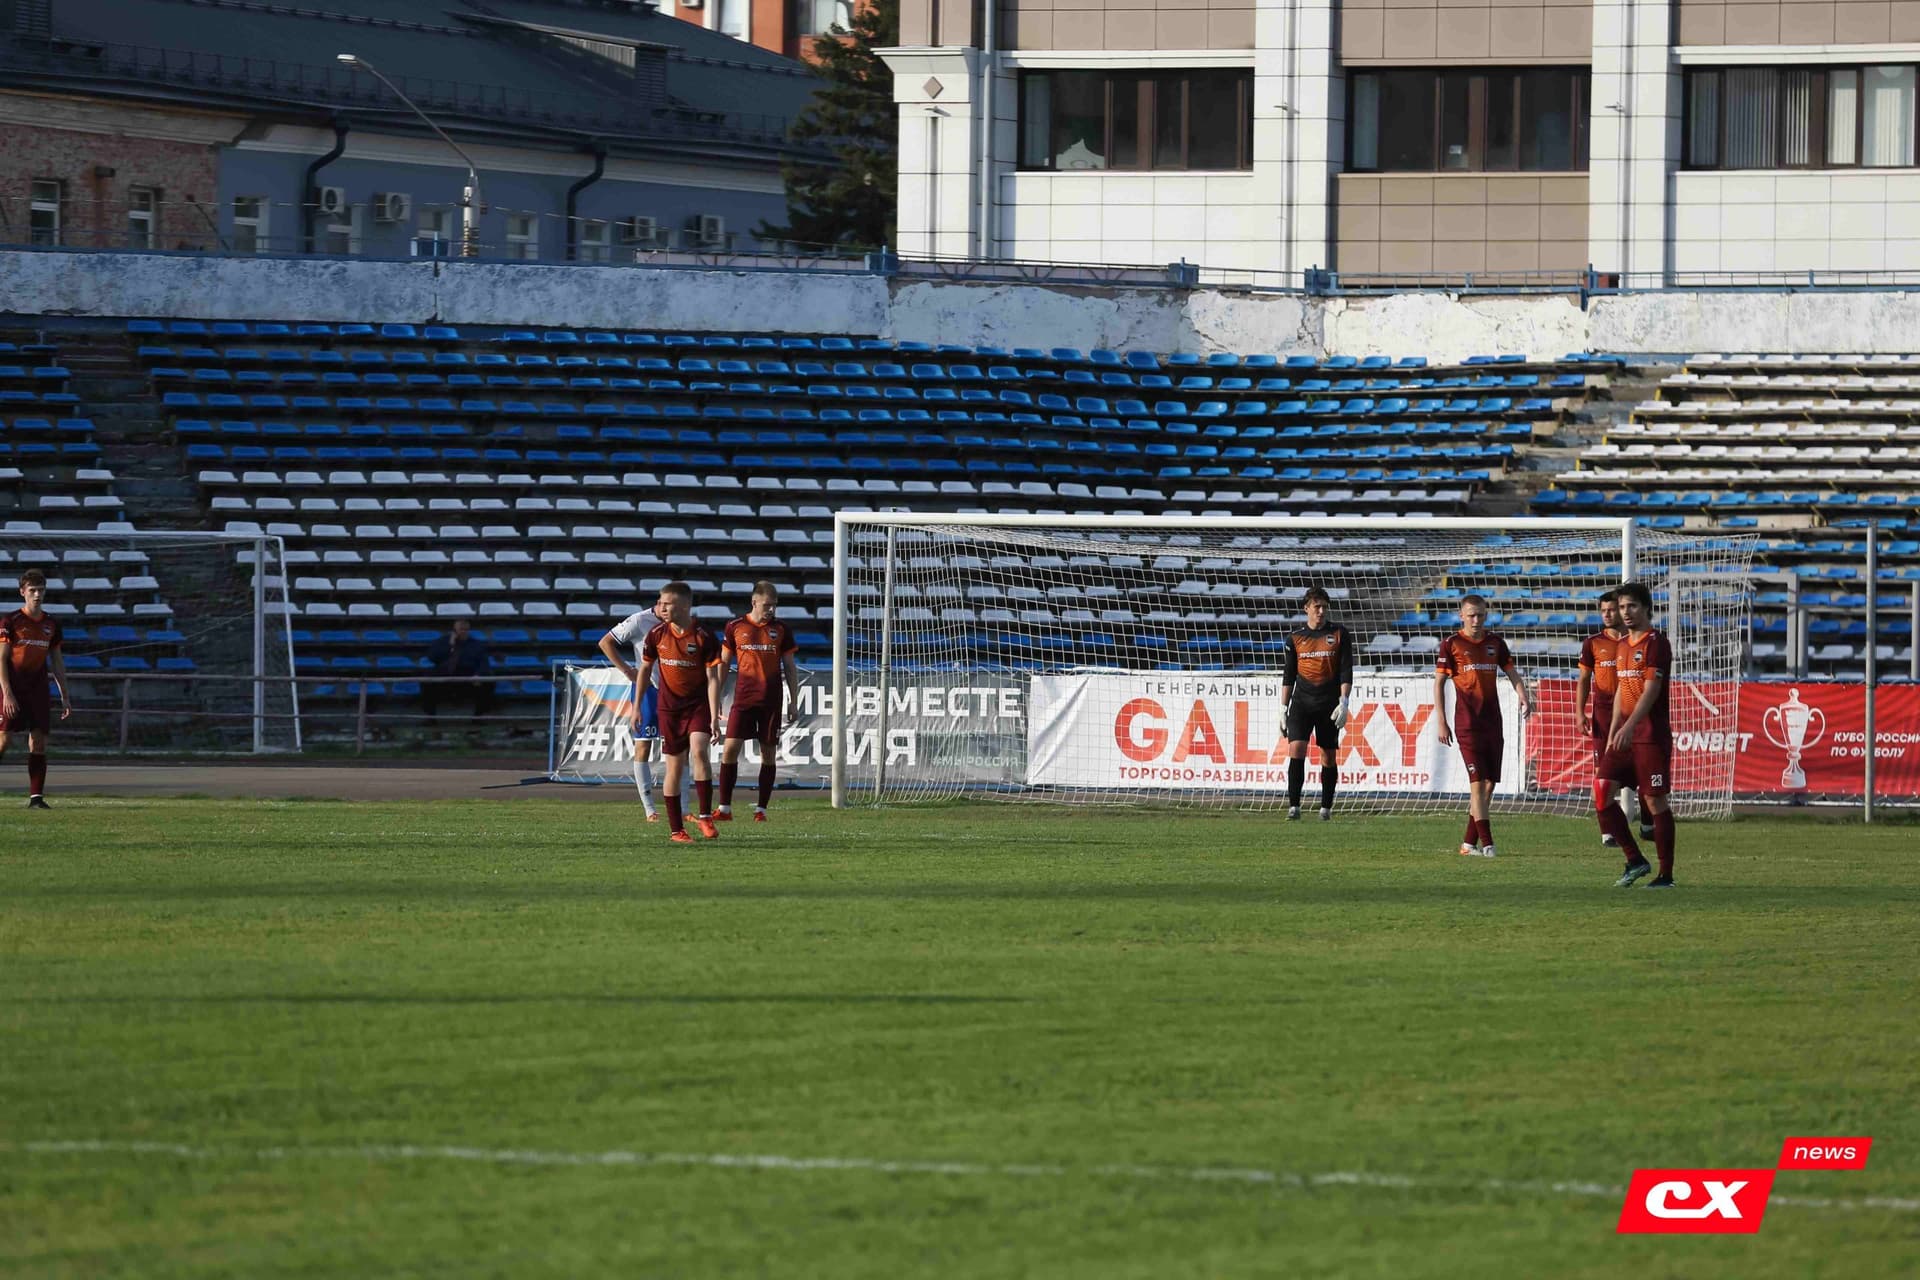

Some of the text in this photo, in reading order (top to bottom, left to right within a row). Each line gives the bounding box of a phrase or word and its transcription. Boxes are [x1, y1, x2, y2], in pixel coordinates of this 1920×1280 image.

[1145, 682, 1404, 698] ГЕНЕРАЛЬНЫ ТНЕР
[645, 725, 657, 737] 30
[1833, 731, 1865, 743] КУБО
[1830, 746, 1906, 758] ПО ФУБОЛУ
[1376, 772, 1430, 788] ЦЕНТР
[1651, 774, 1663, 787] 23
